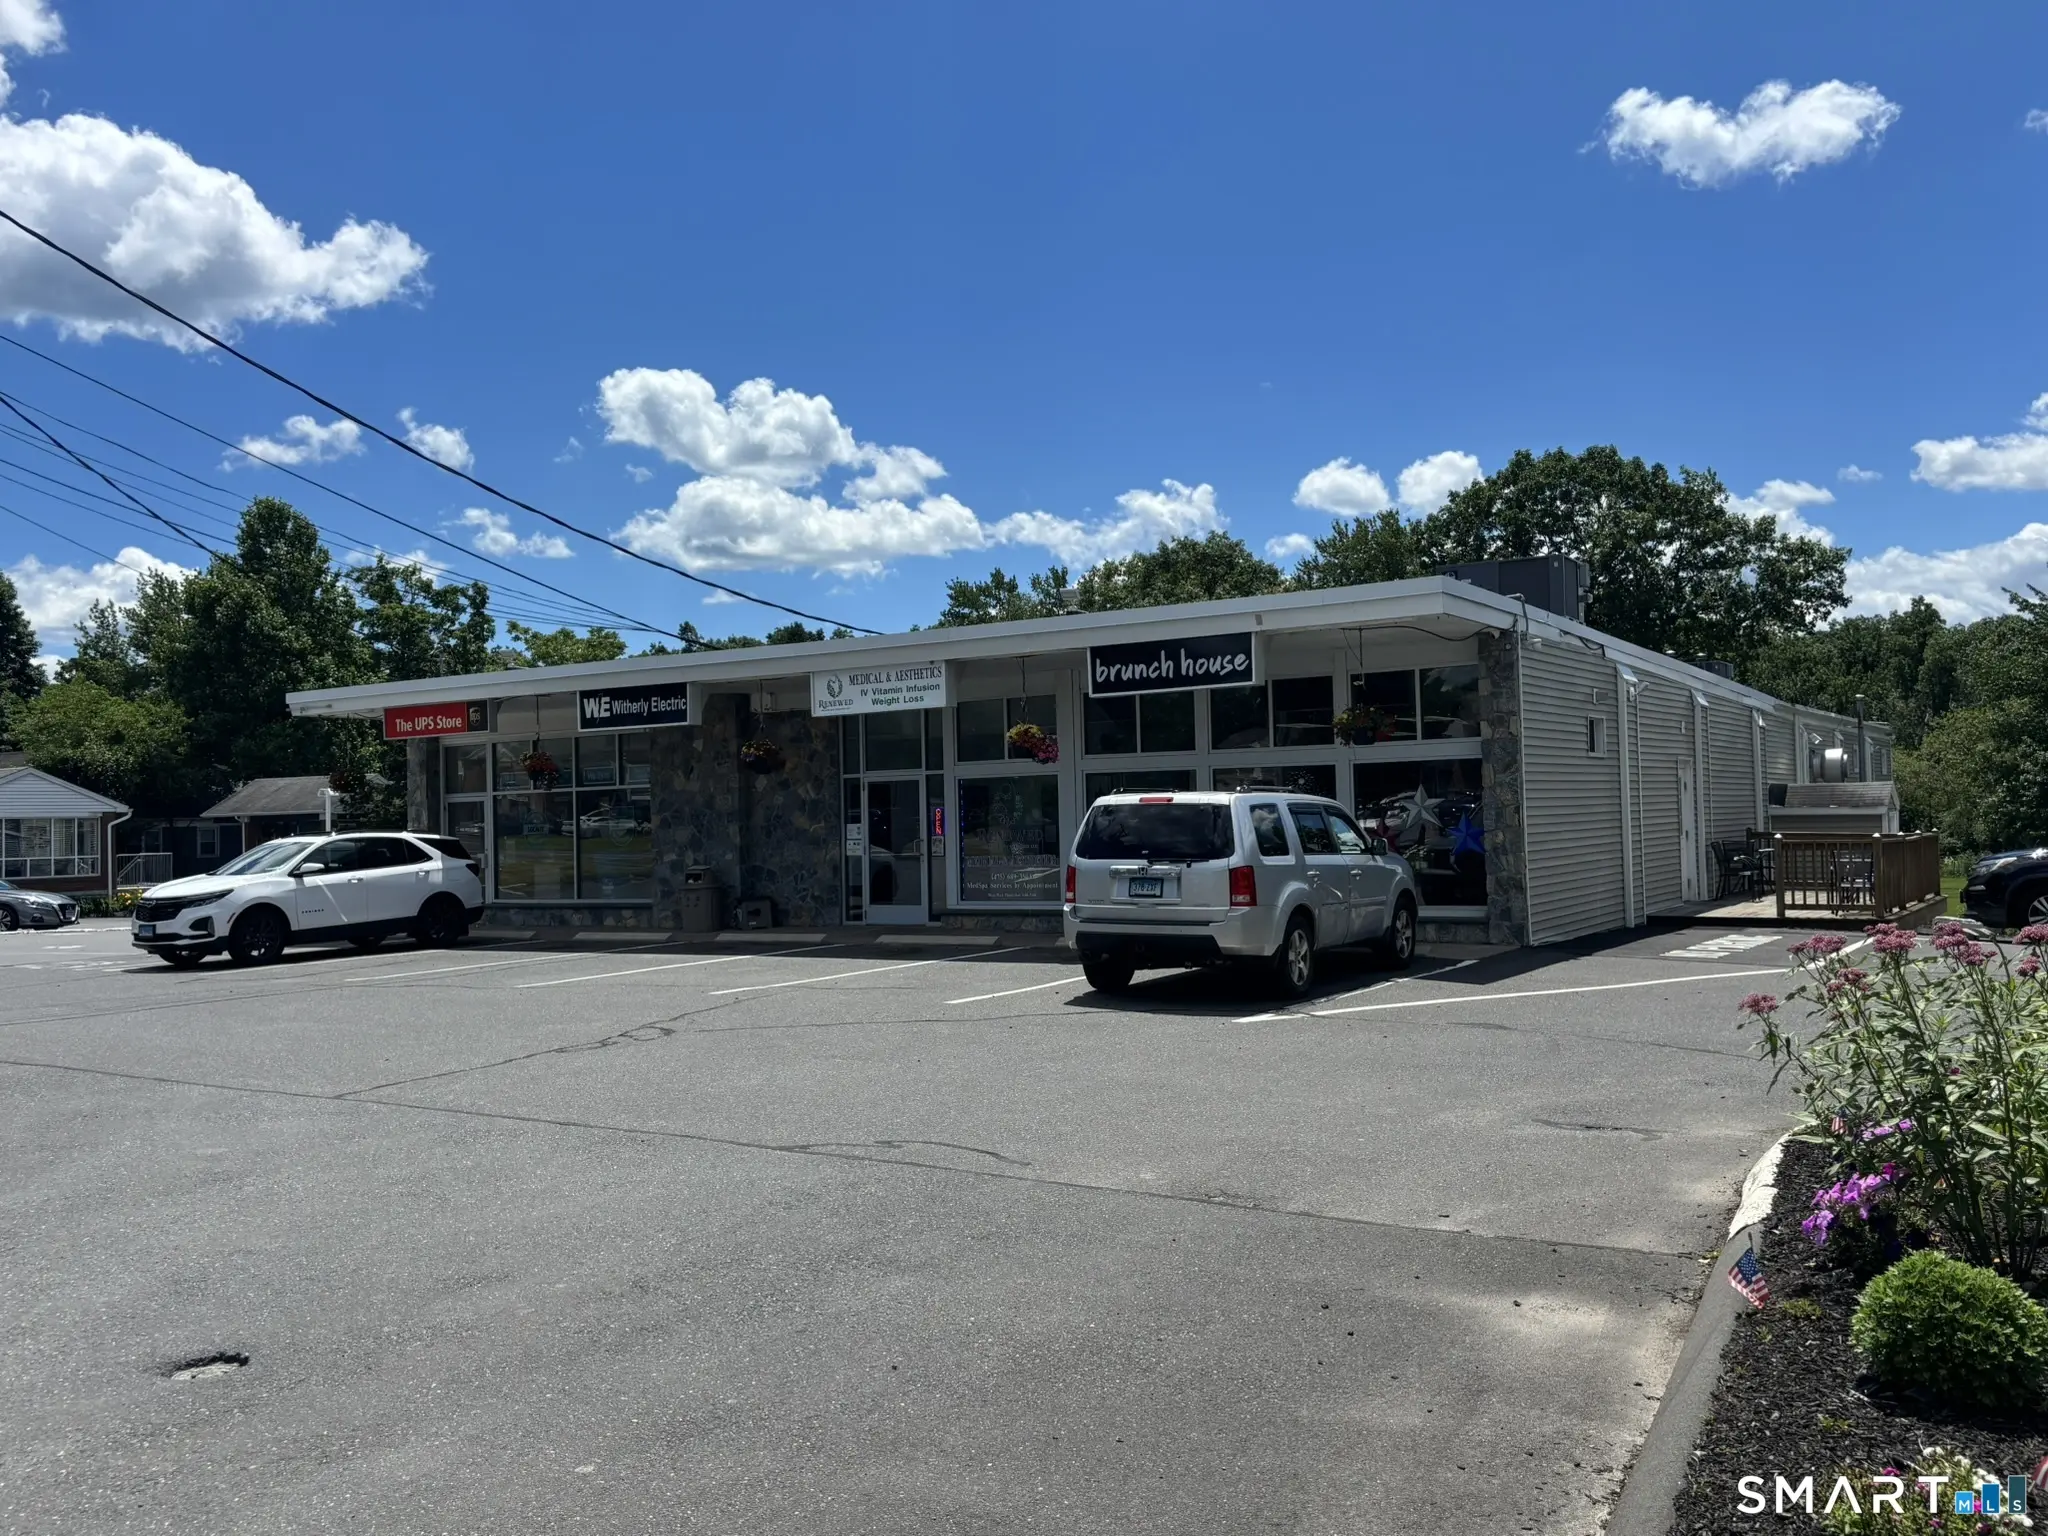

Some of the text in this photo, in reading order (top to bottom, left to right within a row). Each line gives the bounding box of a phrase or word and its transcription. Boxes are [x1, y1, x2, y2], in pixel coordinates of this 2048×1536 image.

[1095, 647, 1250, 683] brunch house
[848, 666, 942, 686] MEDICAL & AESTHETICS
[860, 683, 940, 697] IV Vitamin Infusion
[583, 694, 687, 720] WE Witherly Electric
[818, 698, 854, 710] RENEWED
[871, 694, 924, 706] Weight Loss
[395, 714, 462, 733] The UPS Store
